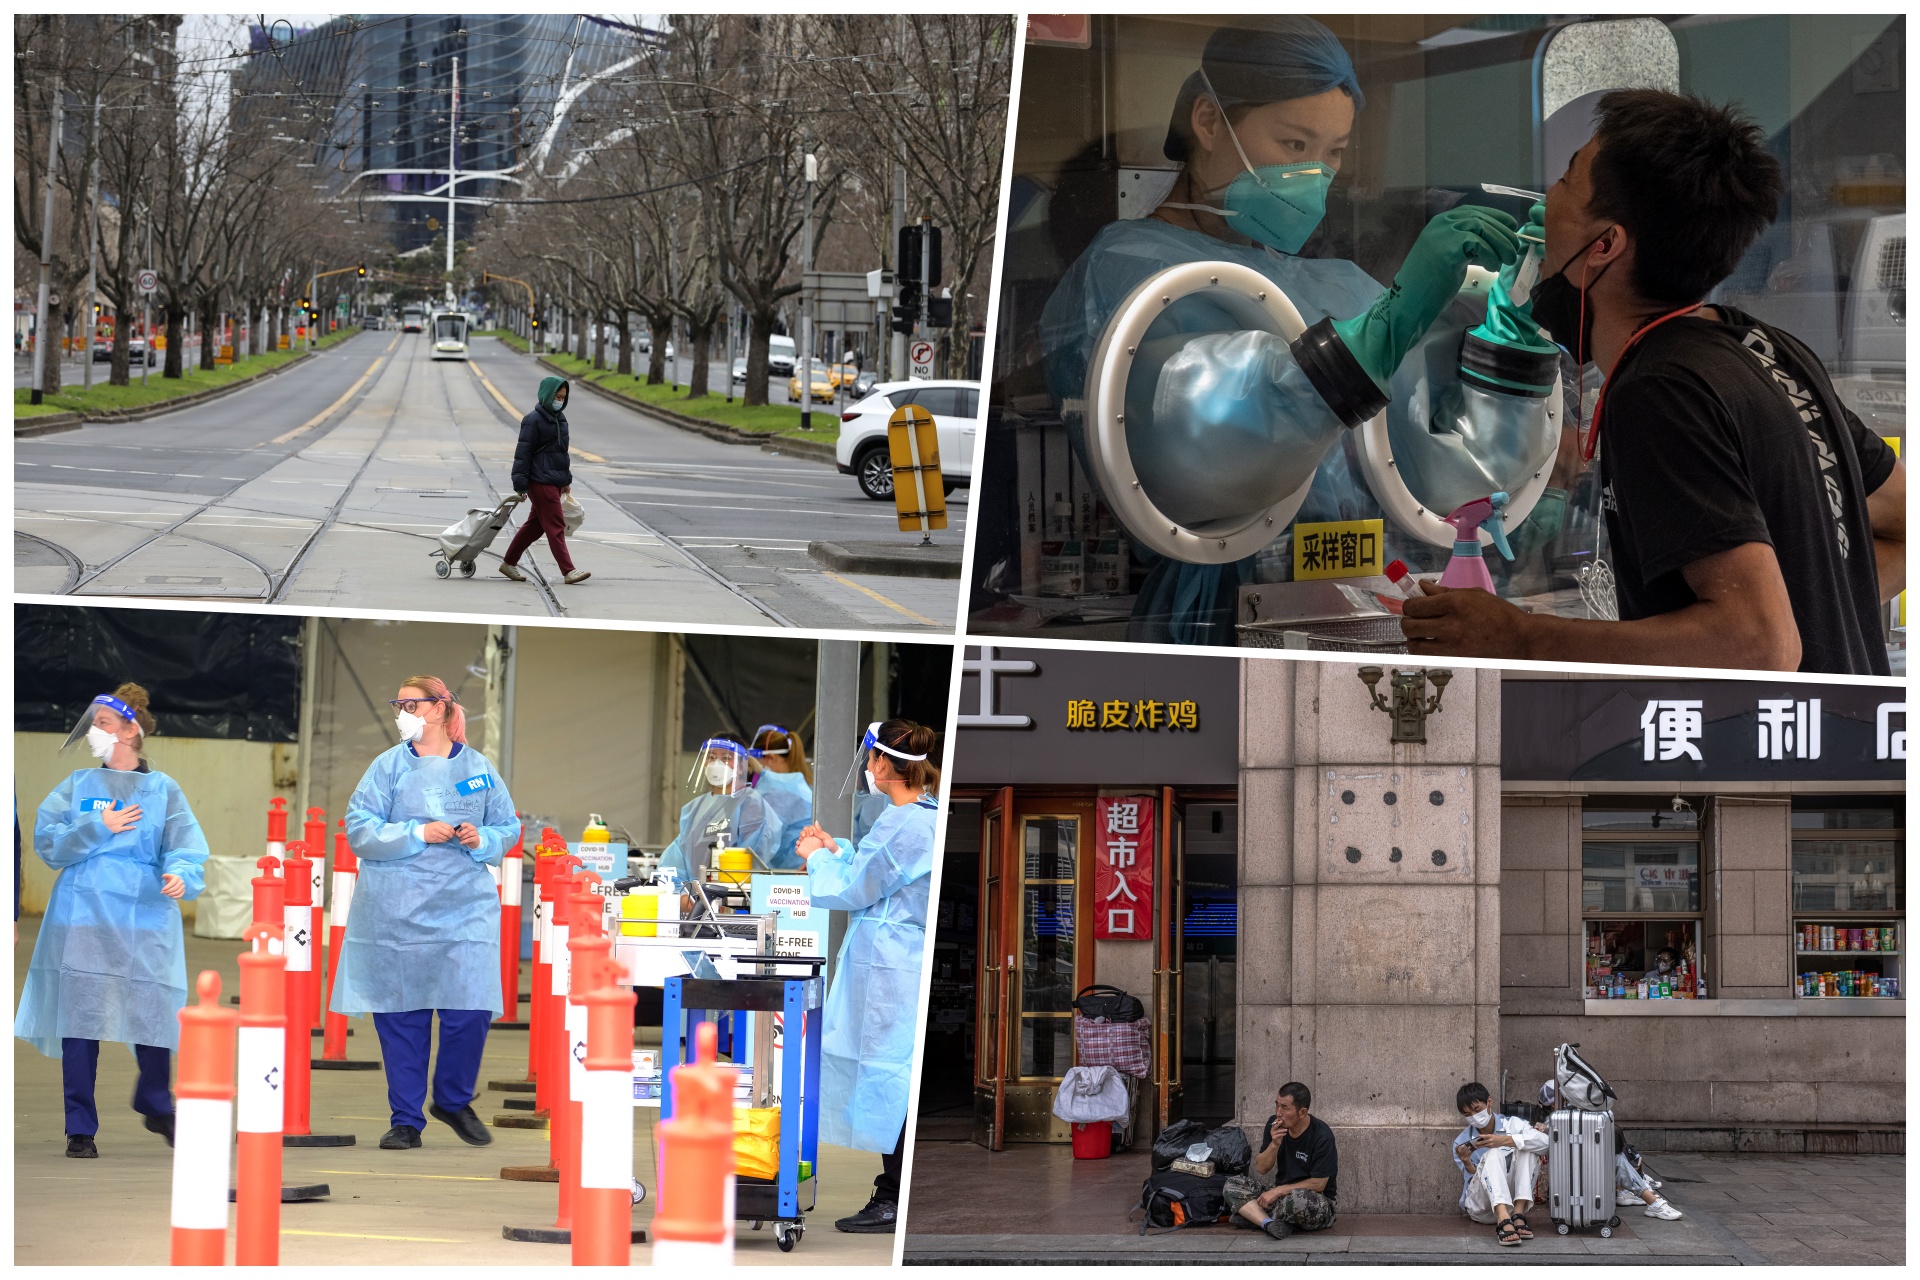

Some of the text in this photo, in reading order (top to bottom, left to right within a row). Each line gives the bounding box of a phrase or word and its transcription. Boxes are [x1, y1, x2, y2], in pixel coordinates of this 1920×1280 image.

[142, 277, 154, 285] 60
[914, 366, 928, 374] NO
[1302, 531, 1376, 572] 采样窗口
[1066, 700, 1199, 729] 脆皮炸鸡
[467, 777, 486, 791] RN
[93, 800, 112, 810] RN
[1106, 802, 1140, 934] 超市入口
